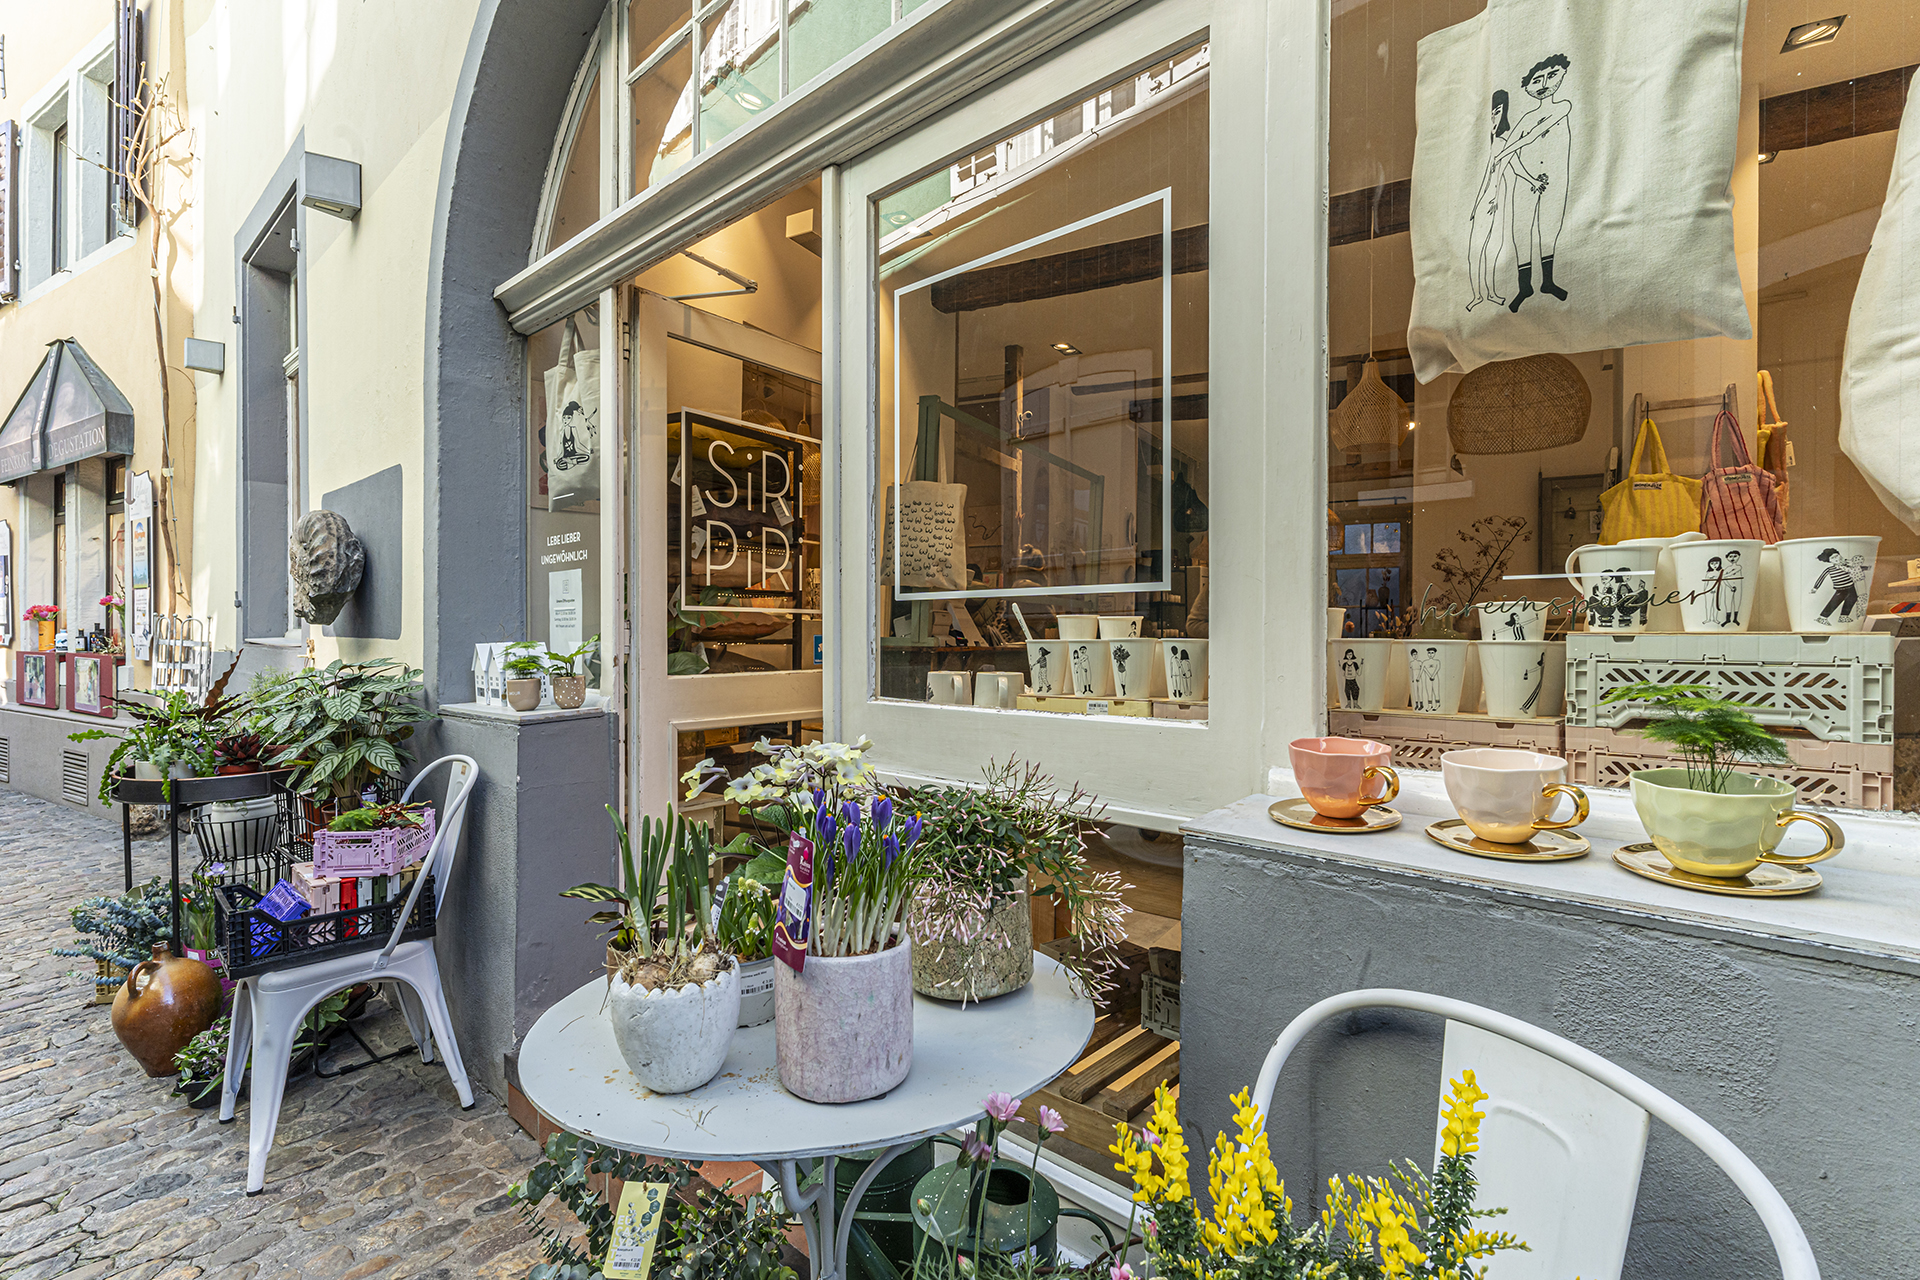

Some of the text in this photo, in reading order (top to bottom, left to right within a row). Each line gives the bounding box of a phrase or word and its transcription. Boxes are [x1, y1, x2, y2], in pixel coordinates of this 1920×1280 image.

[48, 425, 105, 459] DEGUSTATION
[546, 531, 581, 547] LEBE LIEBER
